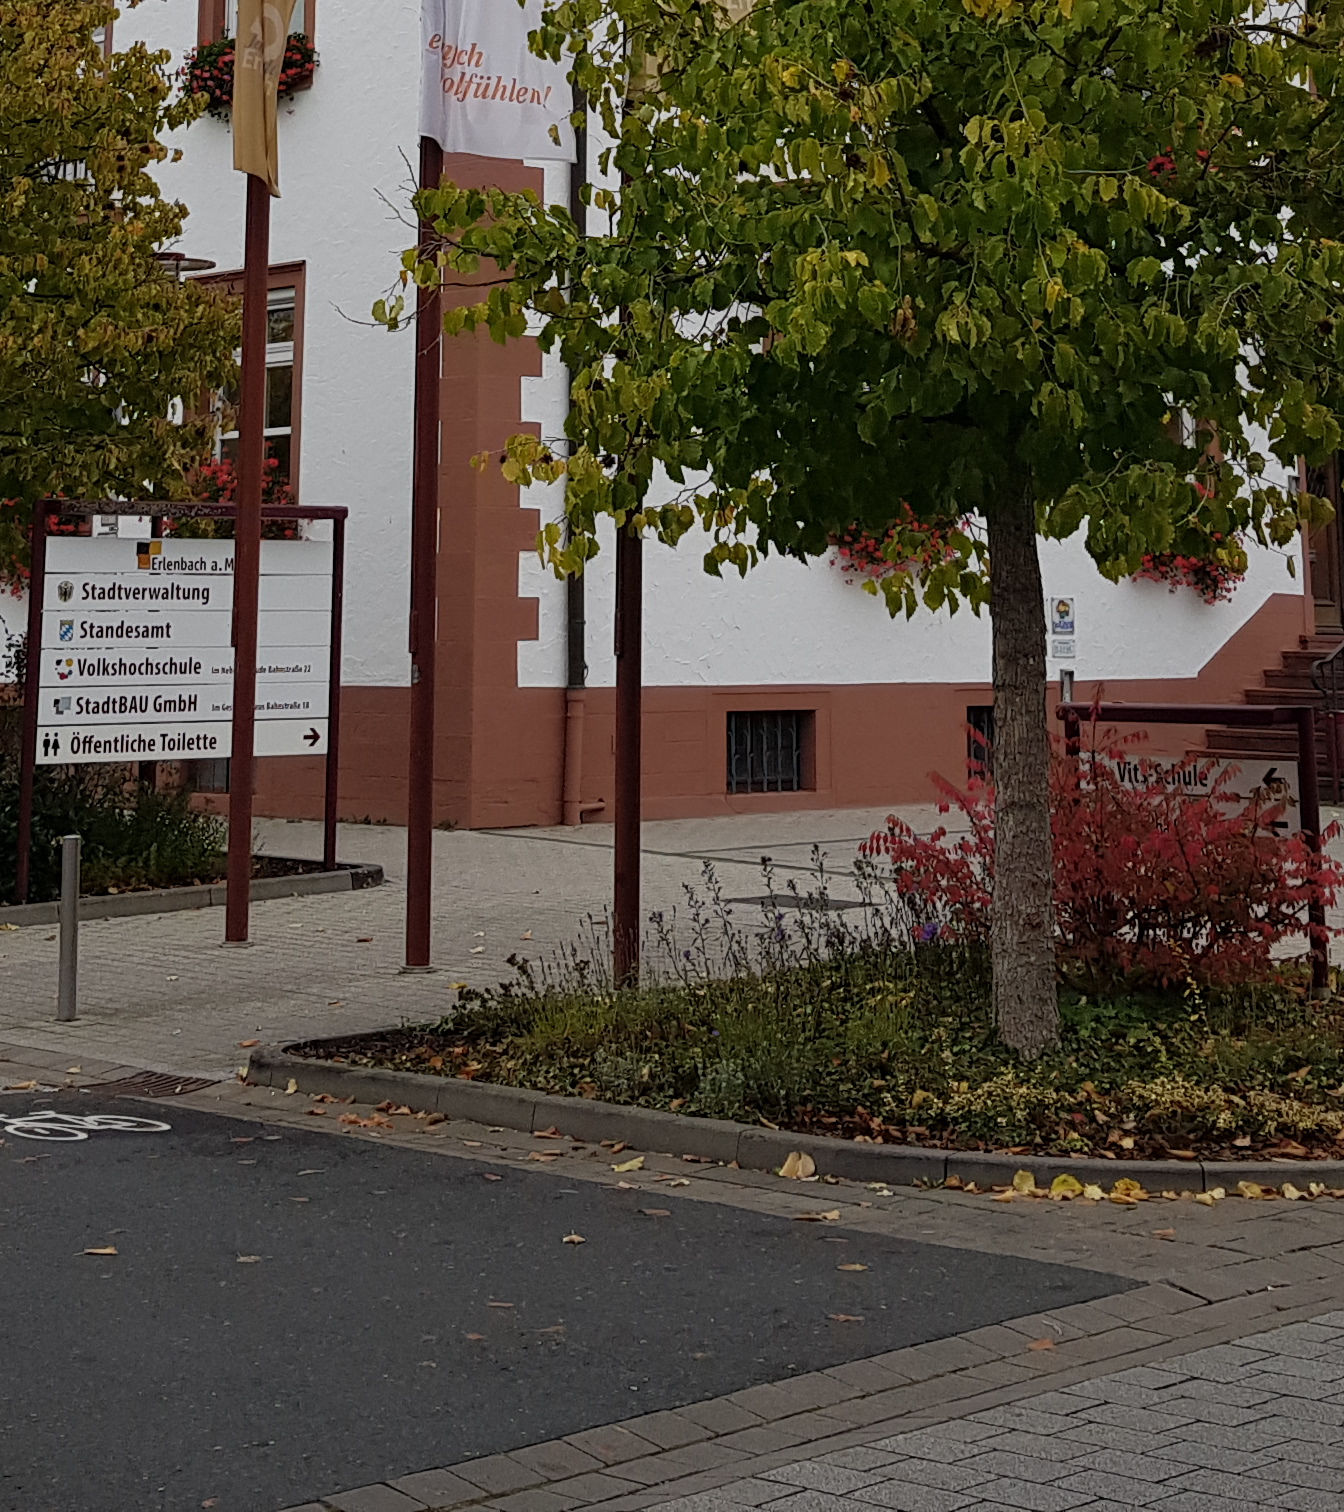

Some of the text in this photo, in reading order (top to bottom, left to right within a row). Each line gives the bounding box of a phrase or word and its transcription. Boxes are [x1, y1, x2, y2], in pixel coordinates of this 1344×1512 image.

[151, 556, 207, 571] Erlenbach
[210, 560, 223, 572] a.
[81, 582, 210, 605] Stadtverwaltung
[79, 621, 172, 639] Standesamt
[77, 657, 202, 677] Volkshochschule
[75, 694, 198, 716] StadtBAU GmbH
[70, 732, 218, 755] Öffentliche Toilette
